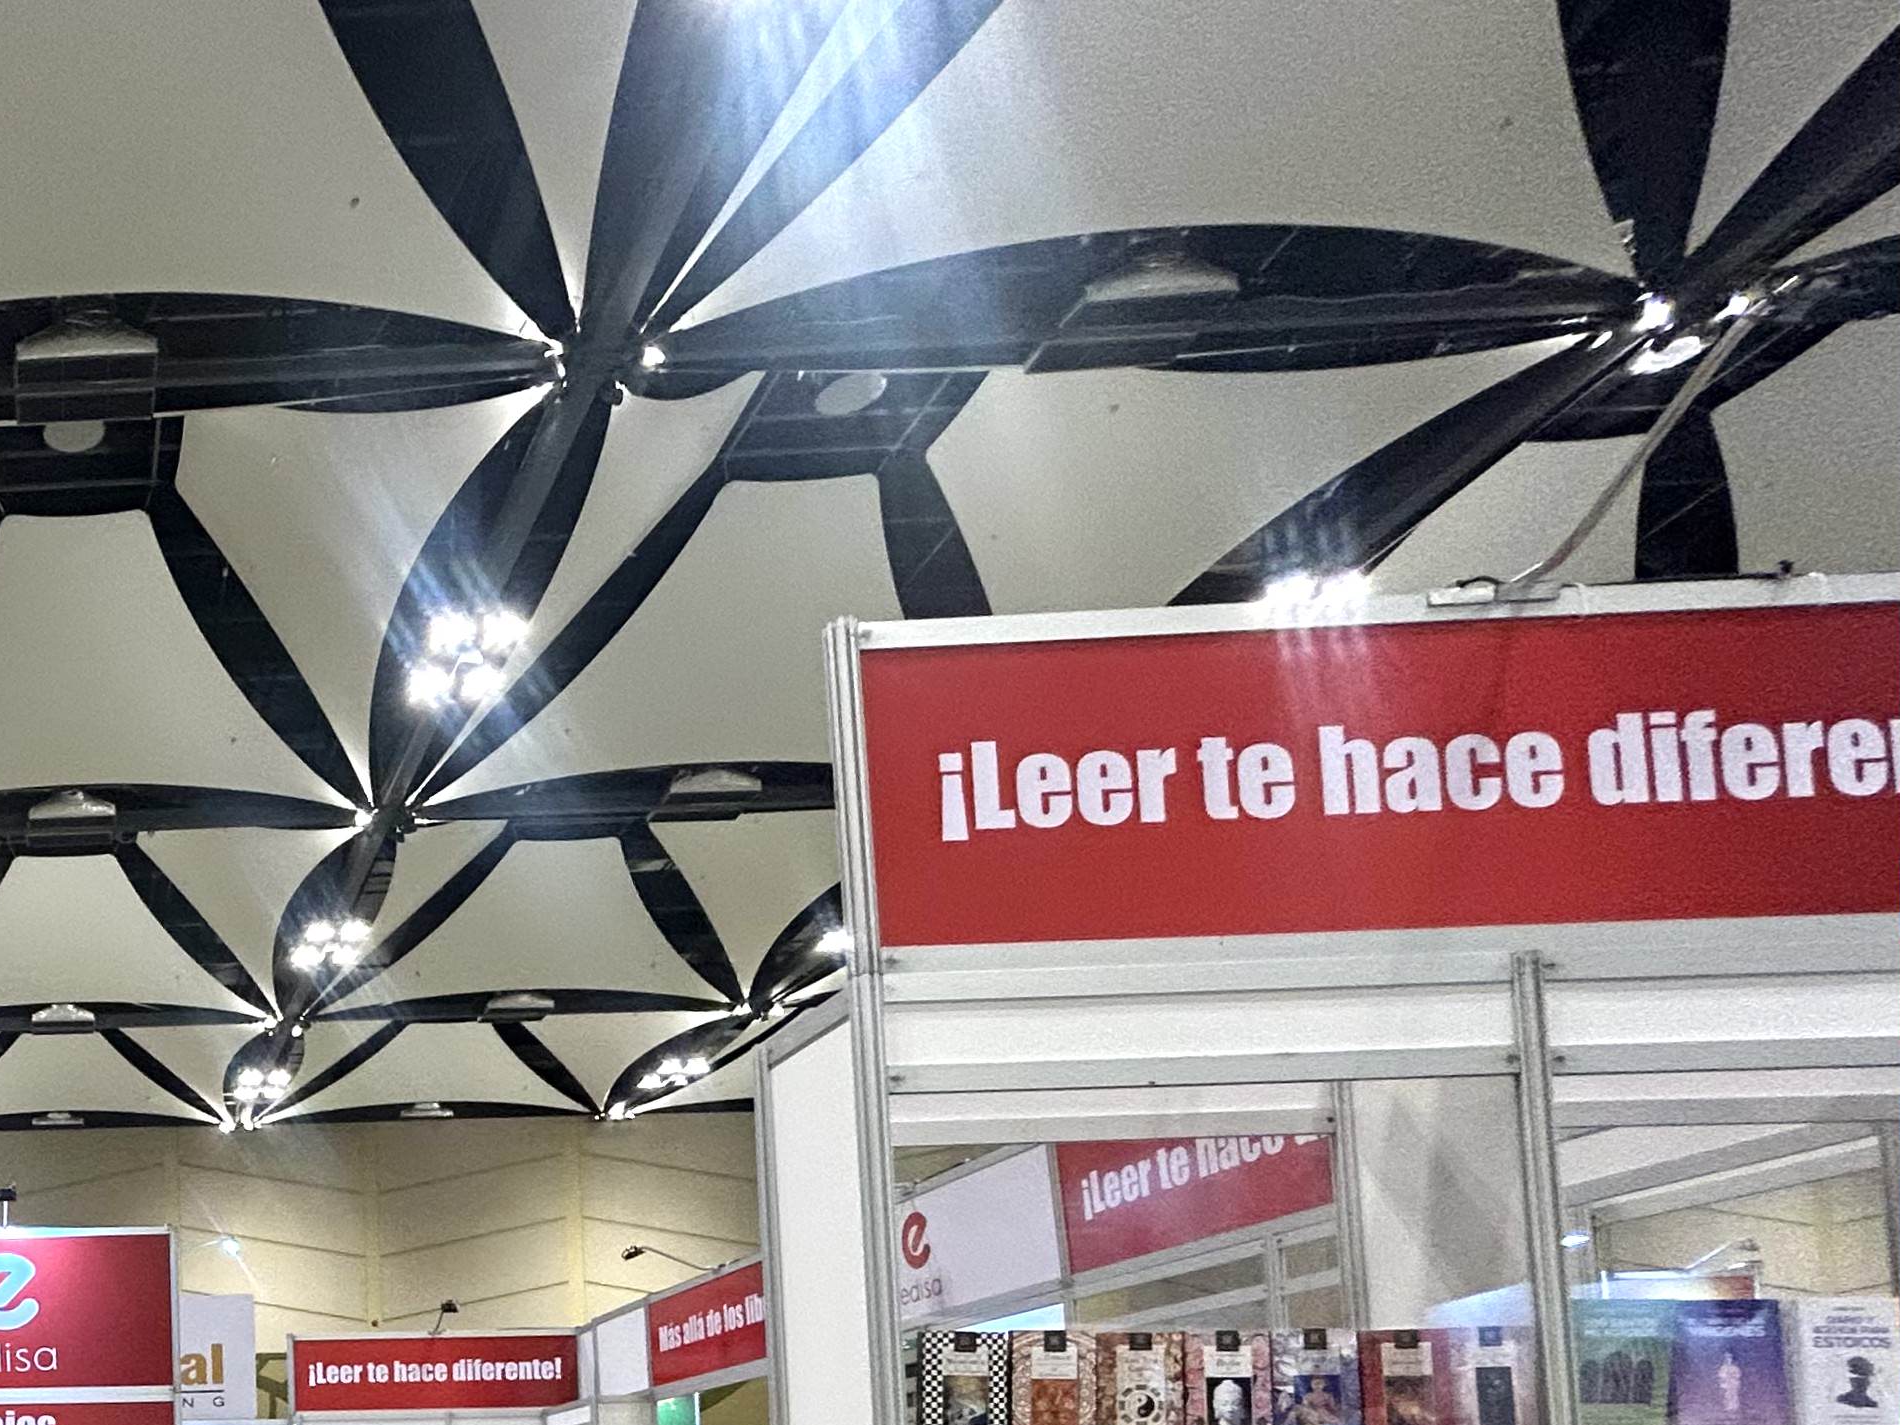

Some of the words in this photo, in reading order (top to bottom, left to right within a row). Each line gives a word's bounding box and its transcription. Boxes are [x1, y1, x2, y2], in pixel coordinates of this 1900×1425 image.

[939, 740, 1177, 842] ¡Leer
[1199, 736, 1296, 821] te
[1320, 723, 1562, 816] hace
[1081, 1164, 1152, 1221] ¡Leer
[1156, 1146, 1190, 1191] te
[658, 1321, 681, 1353] Más
[683, 1312, 705, 1346] allá
[706, 1307, 722, 1338] de
[723, 1302, 745, 1333] los
[308, 1361, 363, 1387] ¡Leer
[367, 1361, 389, 1384] te
[394, 1360, 448, 1383] hace
[453, 1357, 562, 1382] diferente!
